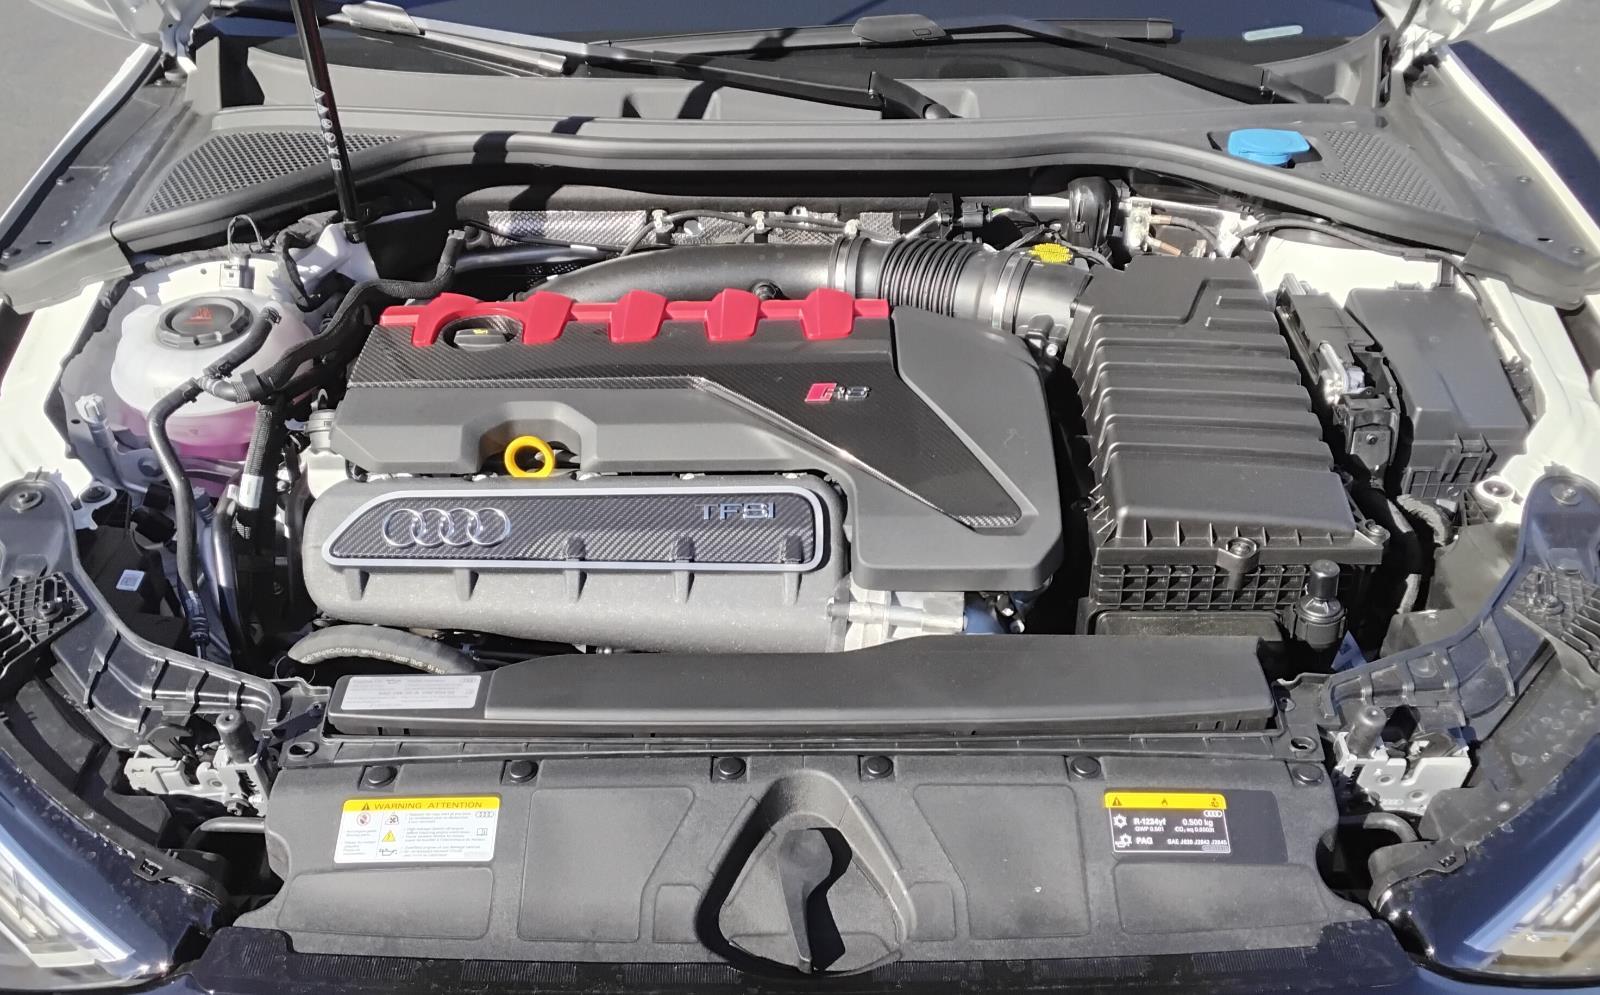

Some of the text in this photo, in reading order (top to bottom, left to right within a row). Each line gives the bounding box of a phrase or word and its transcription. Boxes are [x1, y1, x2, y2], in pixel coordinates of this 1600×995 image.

[694, 502, 775, 520] TFSI
[375, 801, 482, 810] WARNING ATTENTION
[1133, 818, 1214, 828] R-1234yf 0.500 kg
[1135, 837, 1153, 845] PAG
